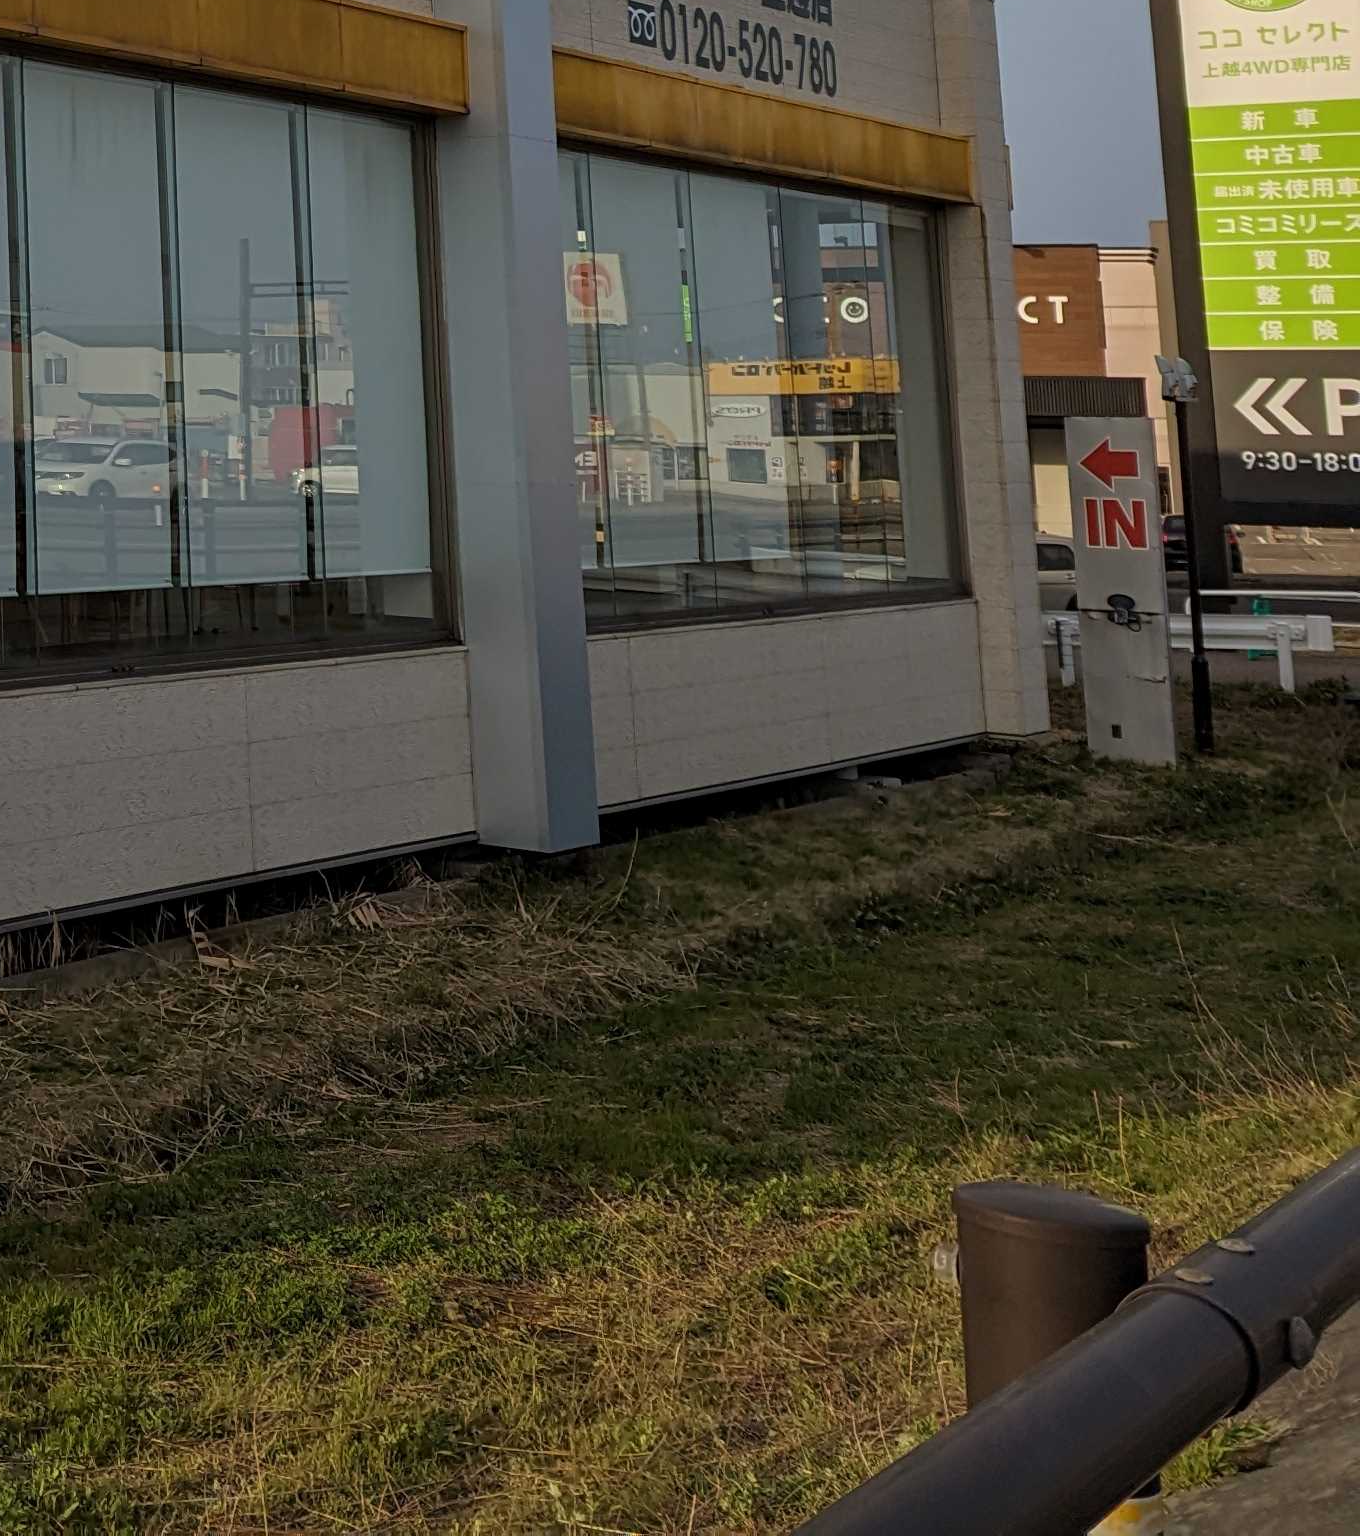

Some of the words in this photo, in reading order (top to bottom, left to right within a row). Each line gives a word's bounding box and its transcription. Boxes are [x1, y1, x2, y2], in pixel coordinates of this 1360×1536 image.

[1198, 29, 1243, 50] ココ
[1256, 21, 1350, 46] セレクト
[1201, 55, 1352, 79] 上越4WD専門店
[1245, 143, 1323, 166] 中古車
[1216, 213, 1360, 236] コミコミリース
[1253, 248, 1332, 271] 買取
[1255, 283, 1336, 306] 整備
[1259, 319, 1340, 341] 保険
[1084, 497, 1149, 550] IN
